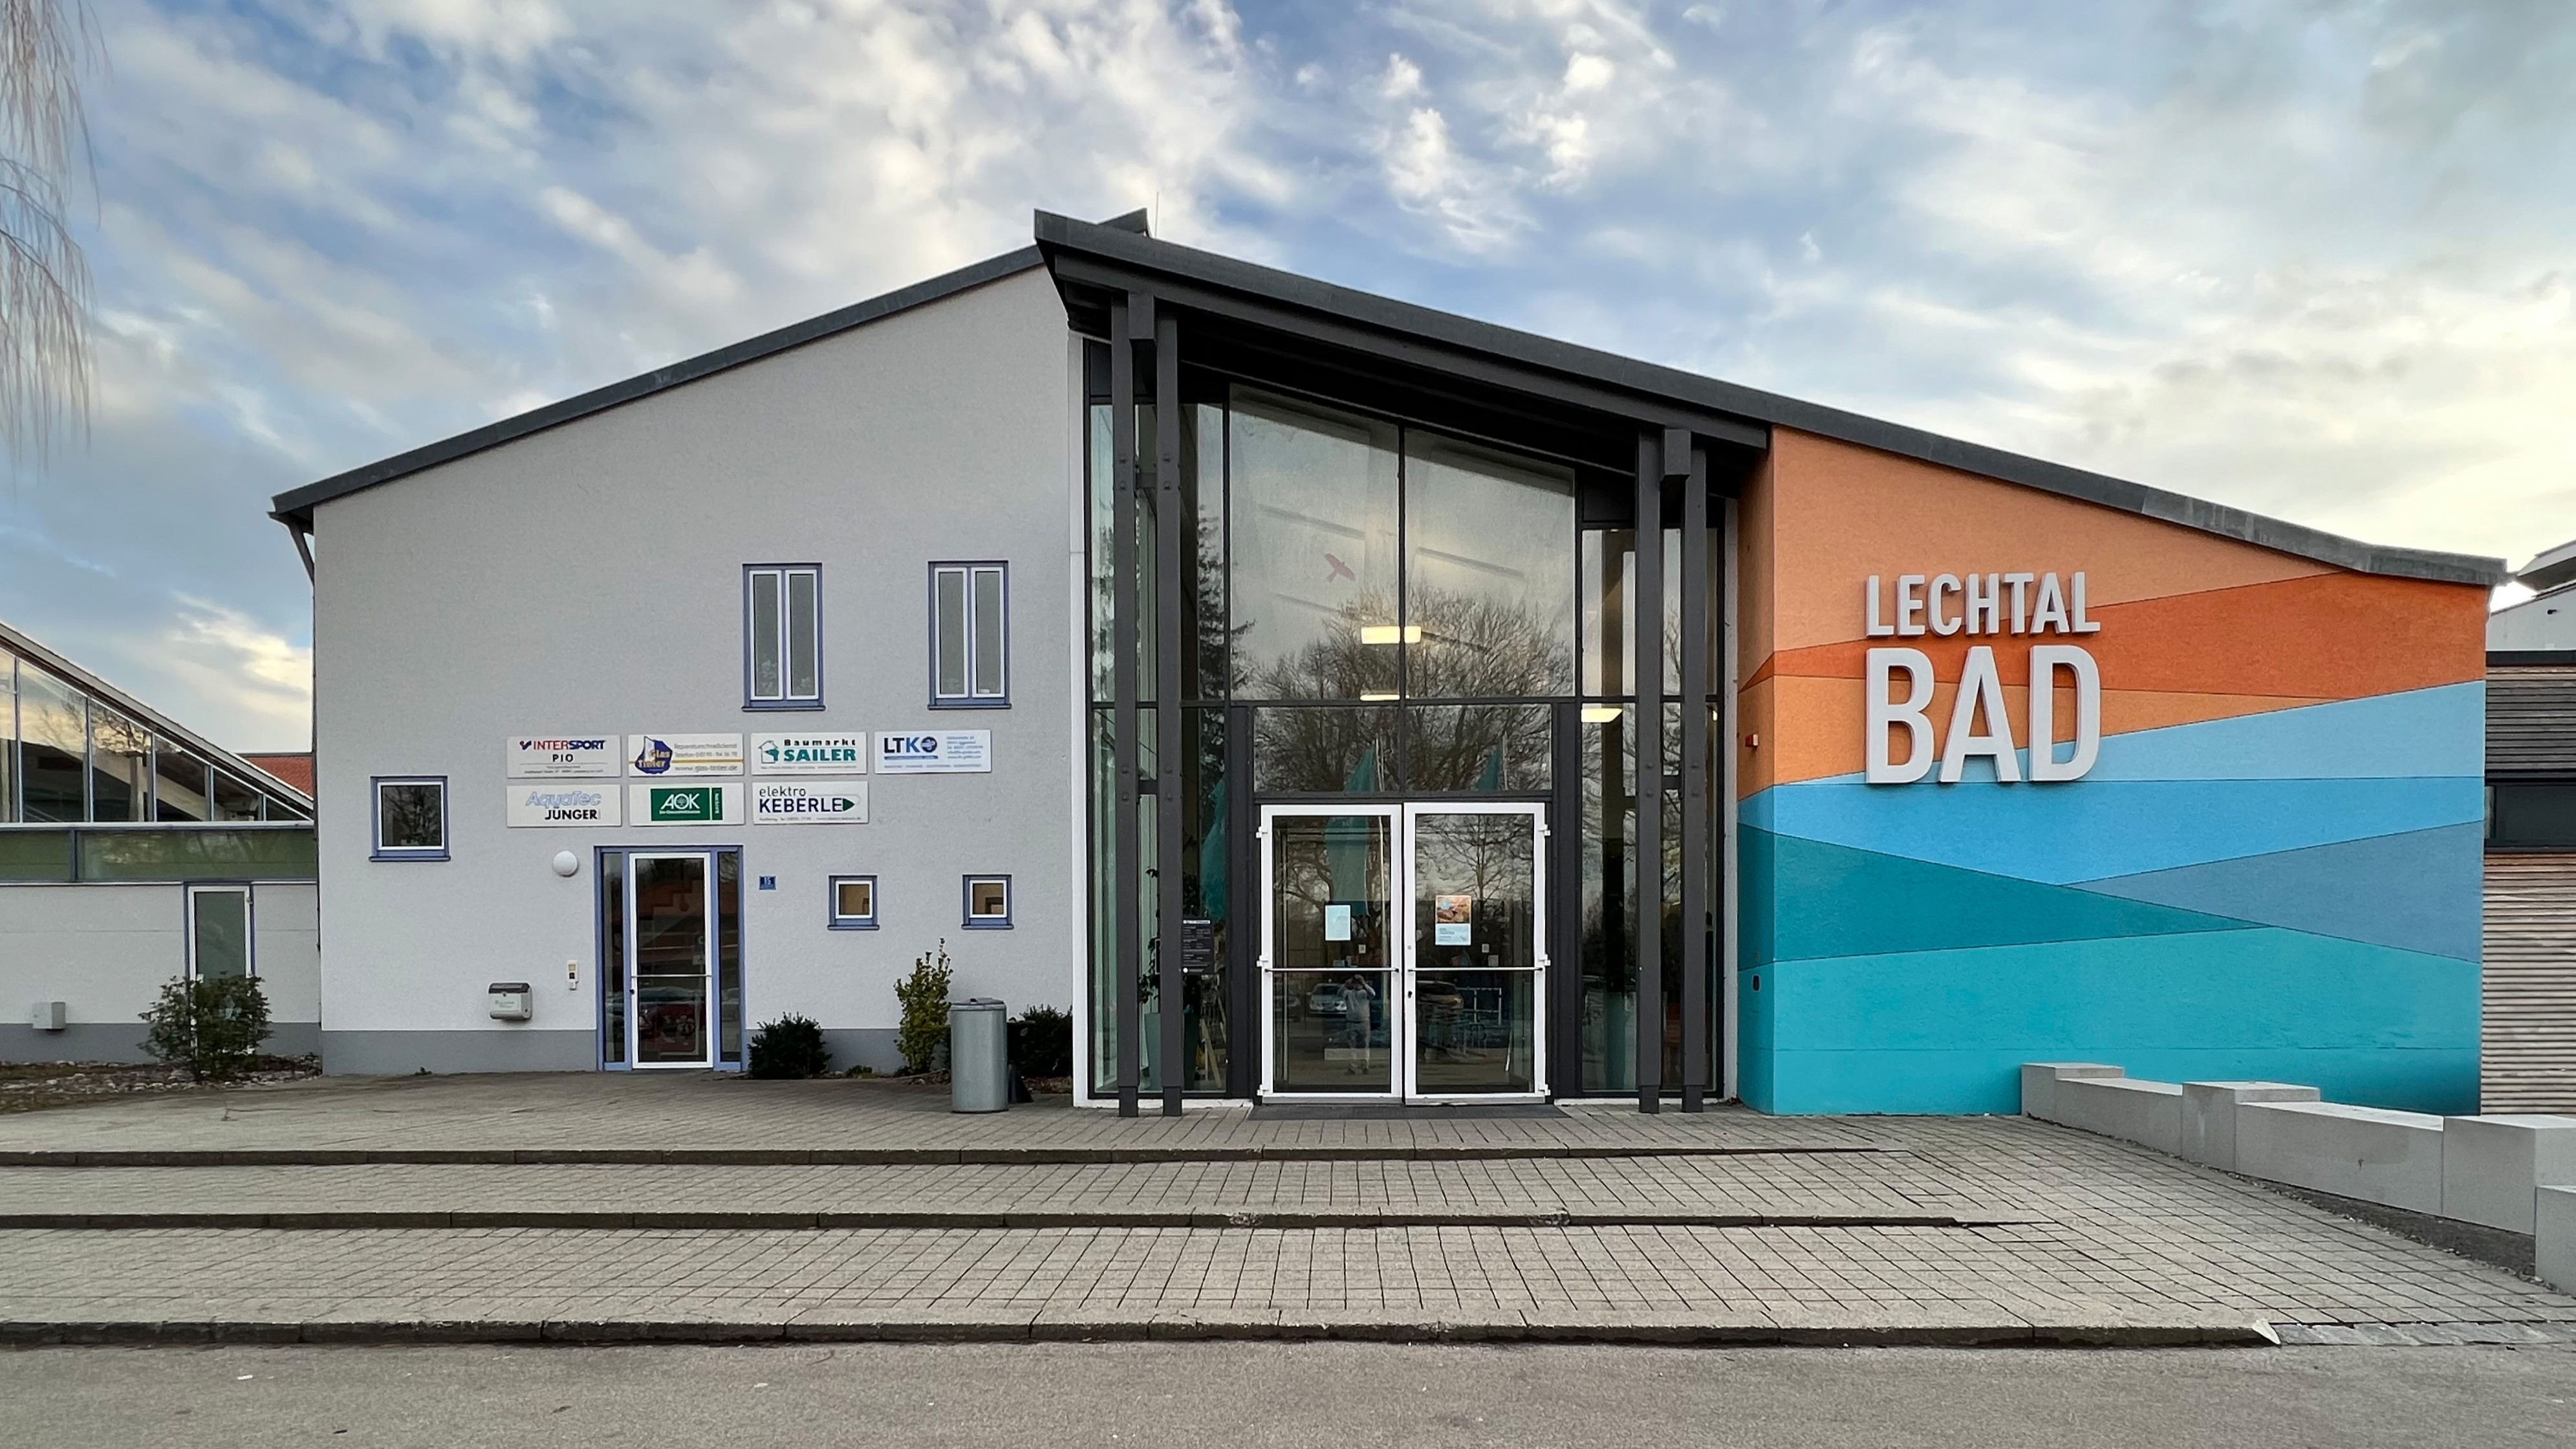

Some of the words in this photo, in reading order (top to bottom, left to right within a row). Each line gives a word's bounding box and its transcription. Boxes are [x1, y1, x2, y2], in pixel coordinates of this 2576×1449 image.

[1867, 572, 2101, 637] LECHTAL
[1866, 644, 2101, 784] BAD
[534, 740, 606, 750] INTERSPORT
[552, 754, 574, 762] PIO
[783, 748, 856, 762] SAILER
[759, 786, 806, 797] elektro
[525, 790, 602, 809] AquaTec
[660, 793, 700, 810] AOK
[759, 798, 843, 813] KEBERLE
[545, 806, 598, 820] JÜNGER
